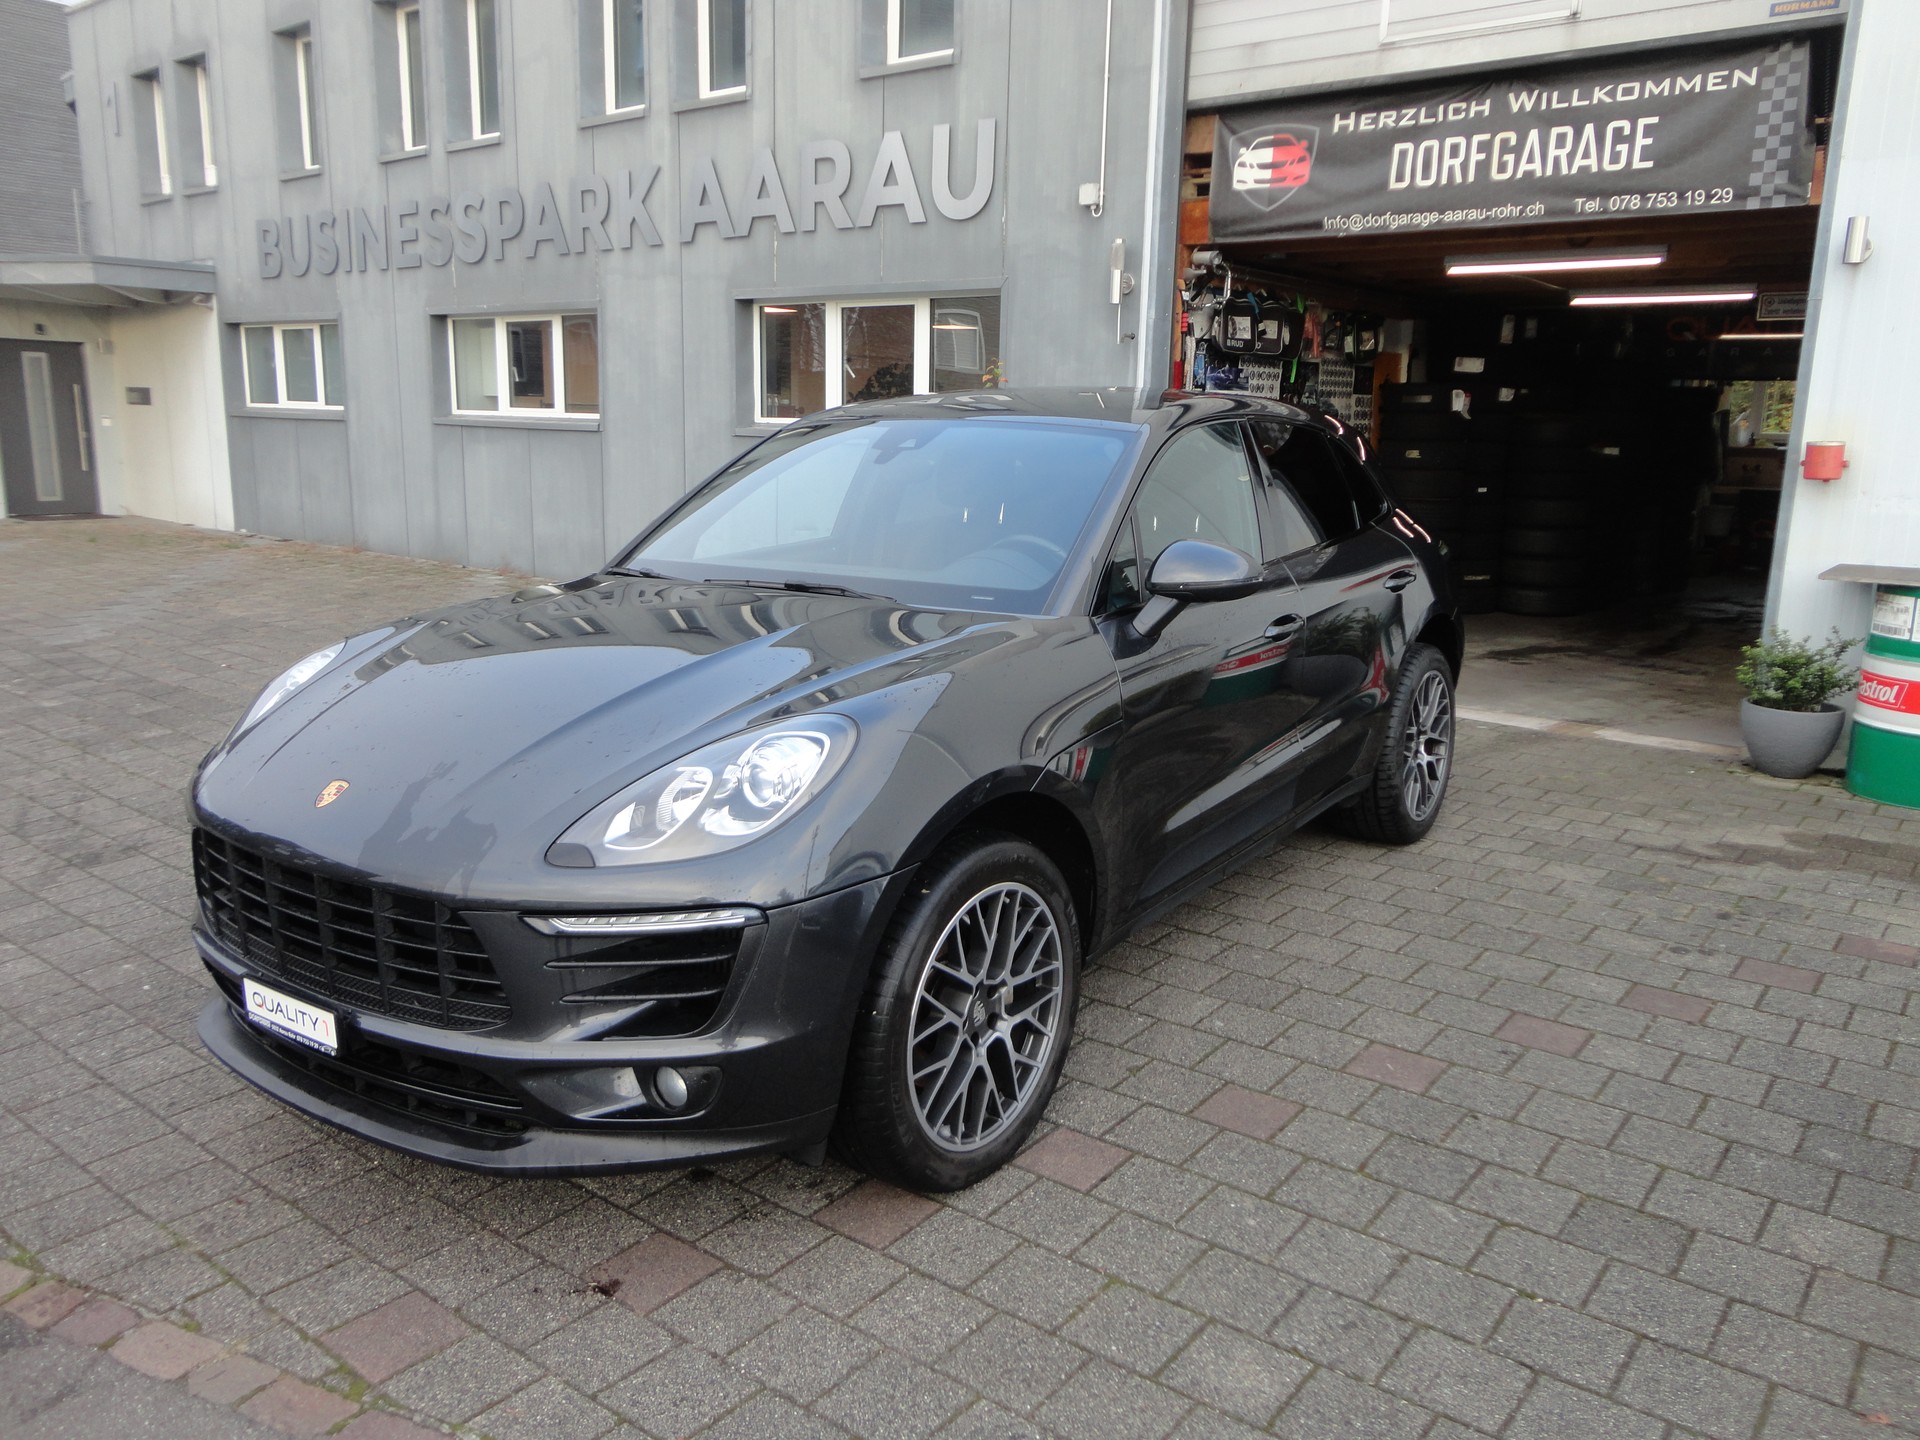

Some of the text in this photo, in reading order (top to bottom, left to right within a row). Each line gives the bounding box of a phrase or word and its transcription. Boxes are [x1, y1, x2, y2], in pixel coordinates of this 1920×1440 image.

[1332, 66, 1759, 134] HERZLICH WILLKOMMEN
[1388, 116, 1660, 190] DORFGARAGE
[254, 118, 996, 280] BUSINESSPARK AARAU
[1324, 201, 1545, 231] Info@dorfgarage-aarau-rohr.ch
[1575, 187, 1733, 213] Tel. 078 753 19 29
[1859, 680, 1899, 703] astrol
[252, 991, 319, 1031] QUALITY
